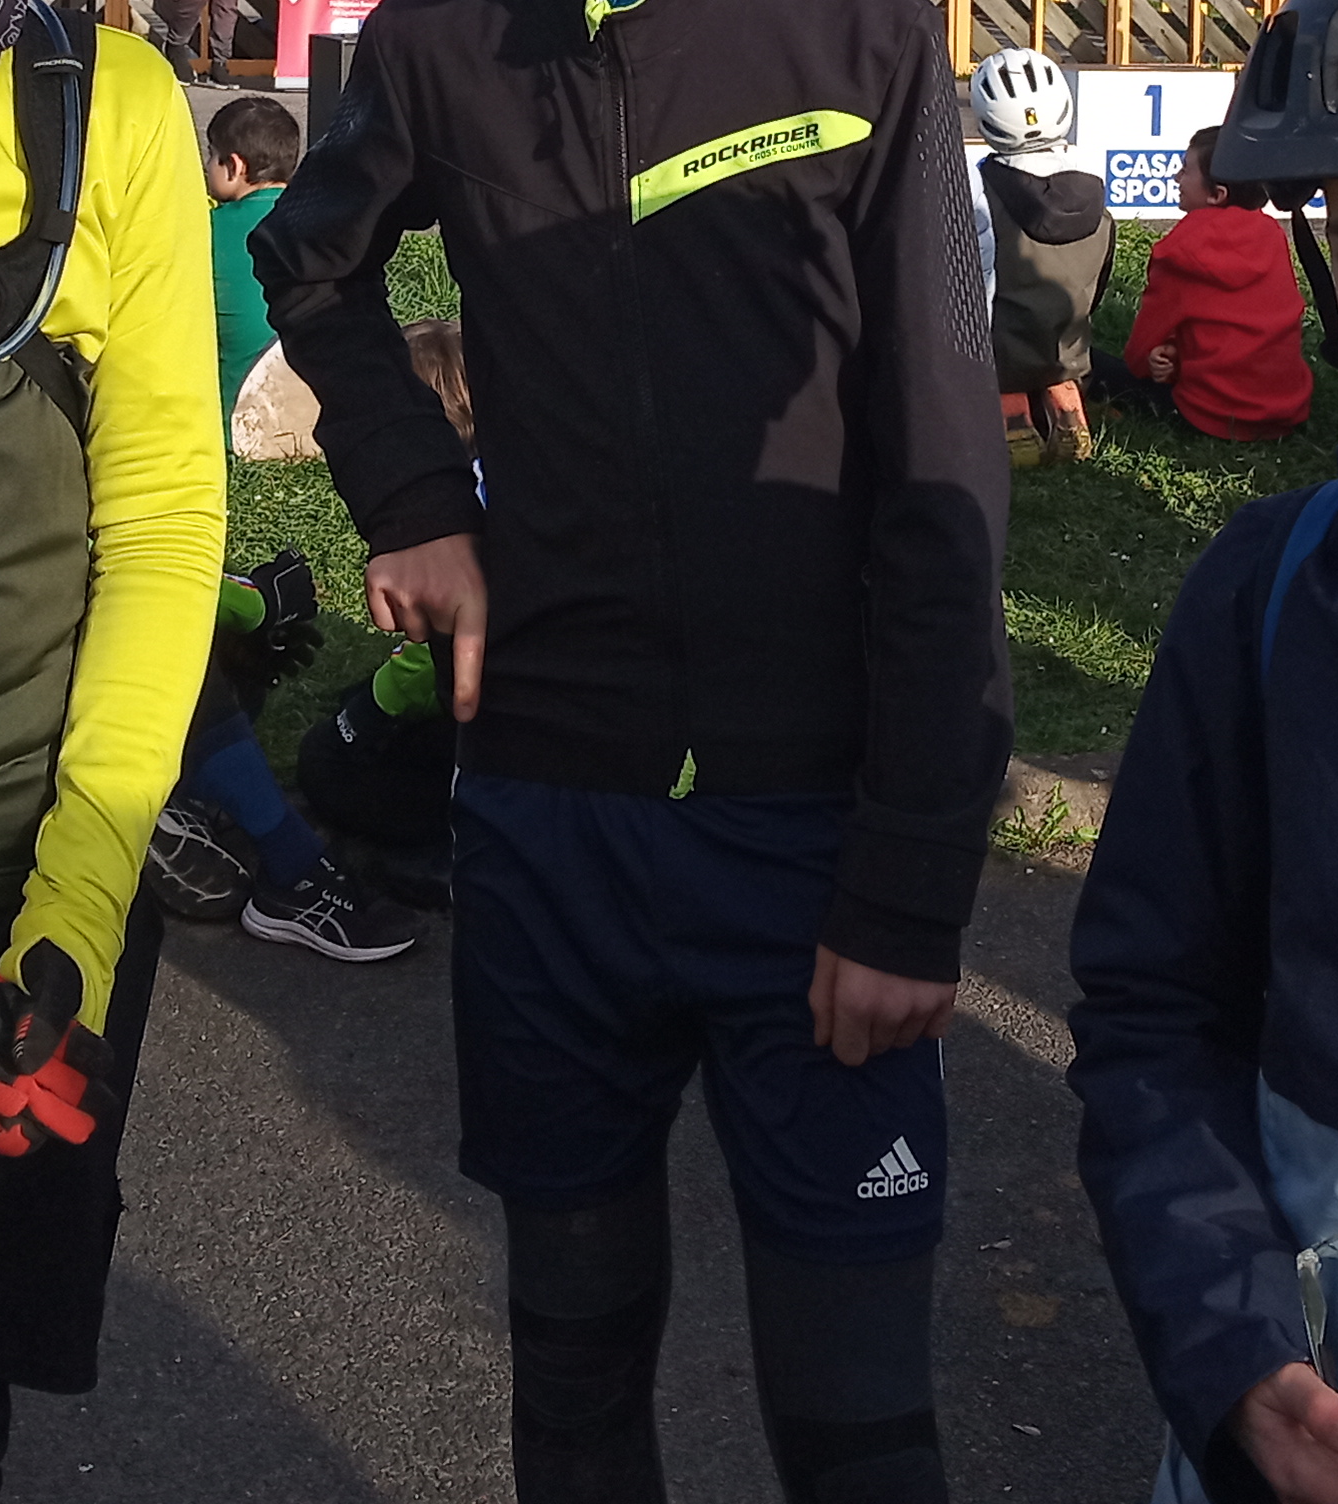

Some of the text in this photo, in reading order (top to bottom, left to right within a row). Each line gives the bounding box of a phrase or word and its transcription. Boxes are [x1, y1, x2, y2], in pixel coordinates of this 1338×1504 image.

[1144, 84, 1162, 136] 1
[683, 122, 819, 178] ROCKRIDER
[749, 138, 820, 163] CROSS COUNTRY
[1109, 152, 1184, 178] CASA
[1109, 178, 1182, 204] SPOR
[857, 1171, 929, 1199] adidas
